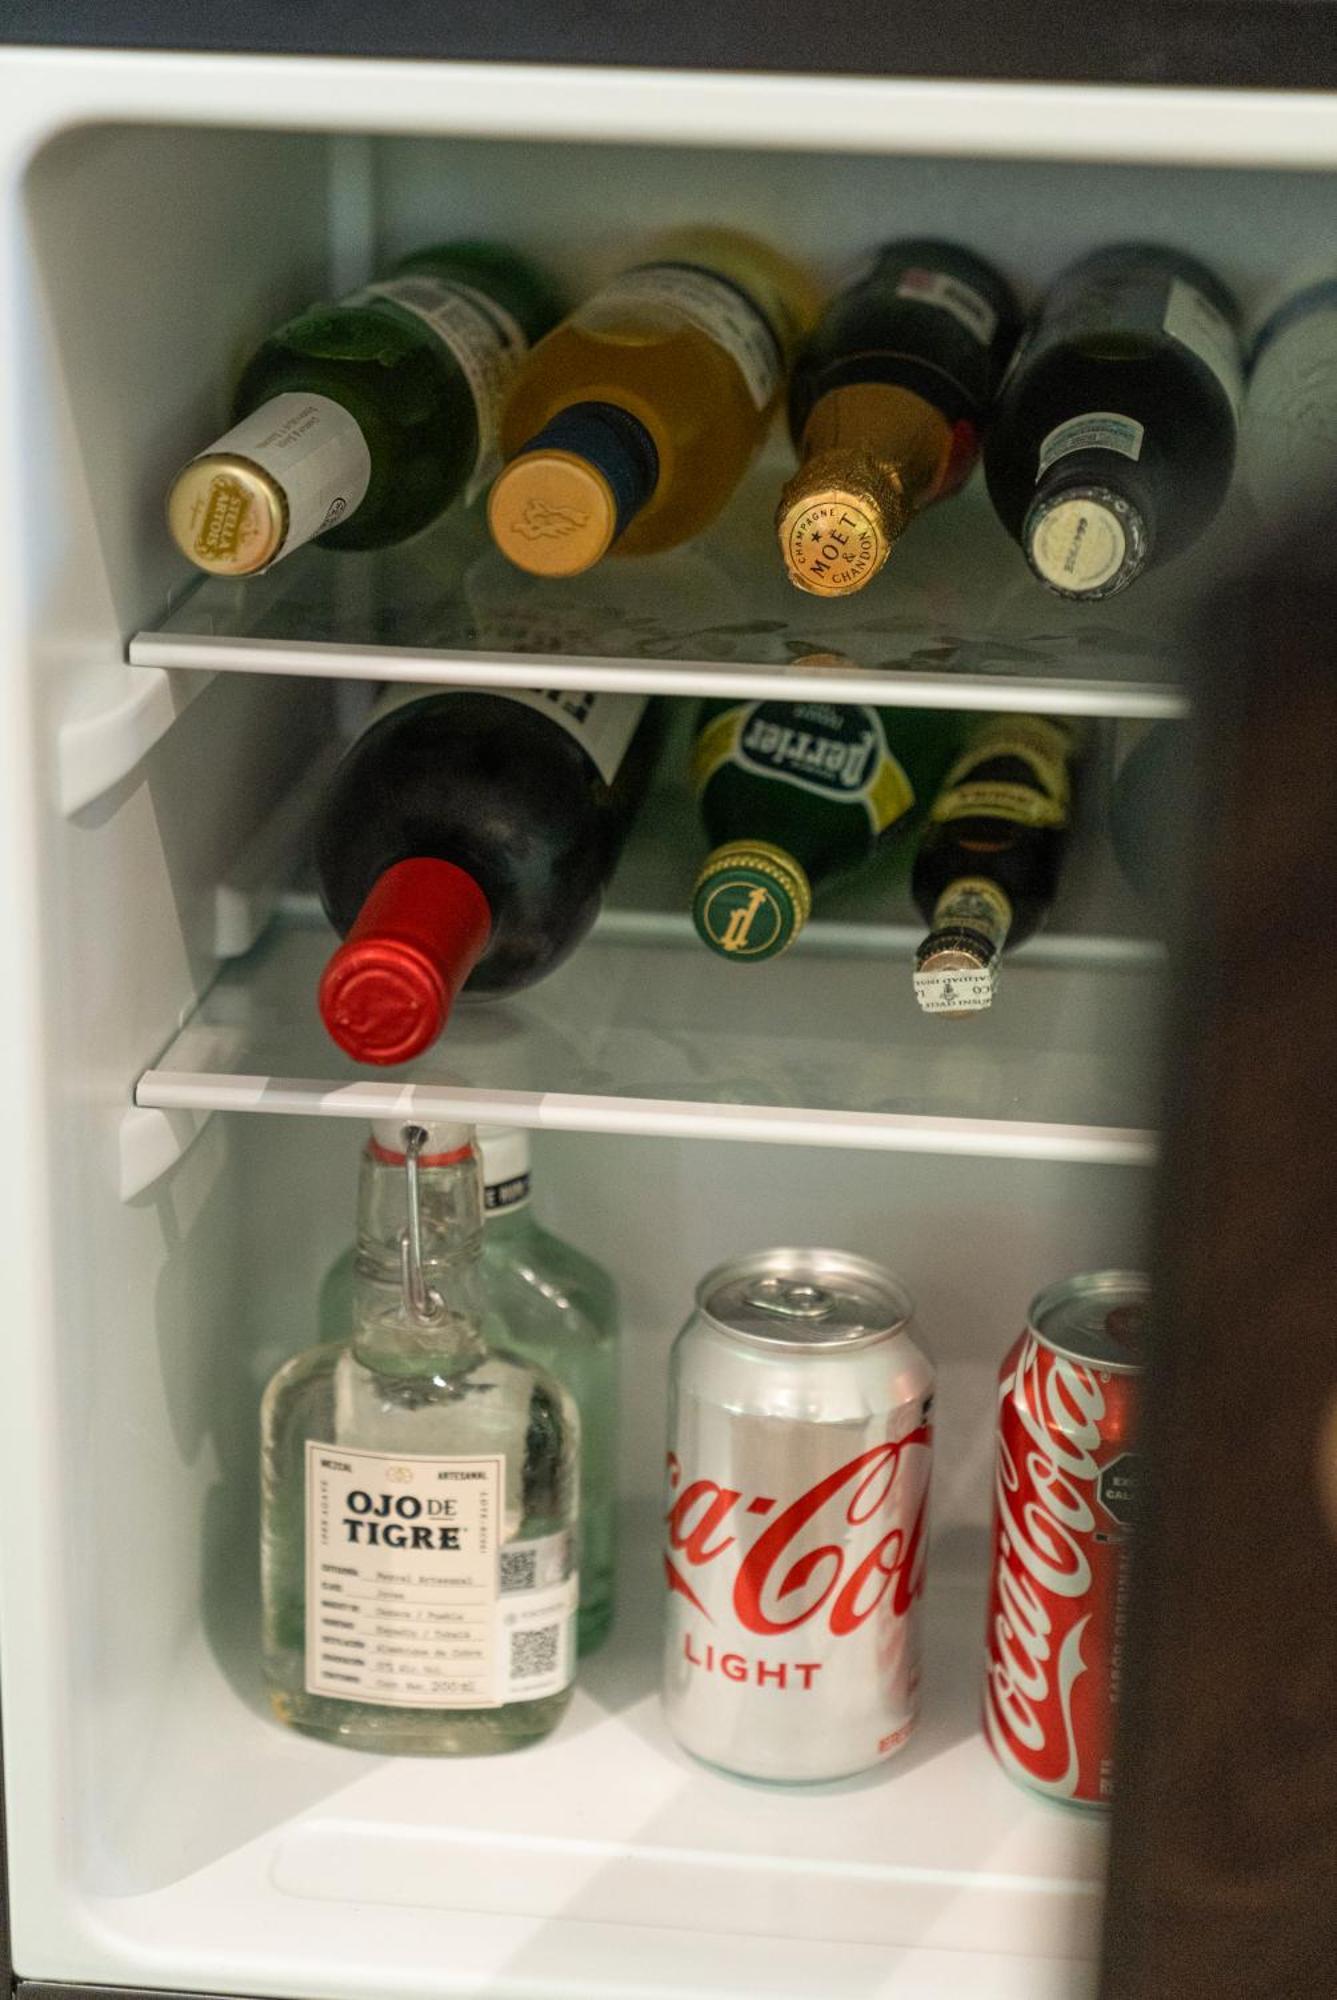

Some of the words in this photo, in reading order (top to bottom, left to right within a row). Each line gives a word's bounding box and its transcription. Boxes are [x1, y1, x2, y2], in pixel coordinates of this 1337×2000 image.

[219, 496, 241, 549] STELLA
[795, 509, 834, 564] CHAMPAGNE
[832, 532, 872, 583] CHANDON
[346, 1490, 422, 1519] OJO
[427, 1499, 457, 1516] DE
[342, 1518, 461, 1550] TIGRE
[686, 1633, 822, 1690] LIGHT
